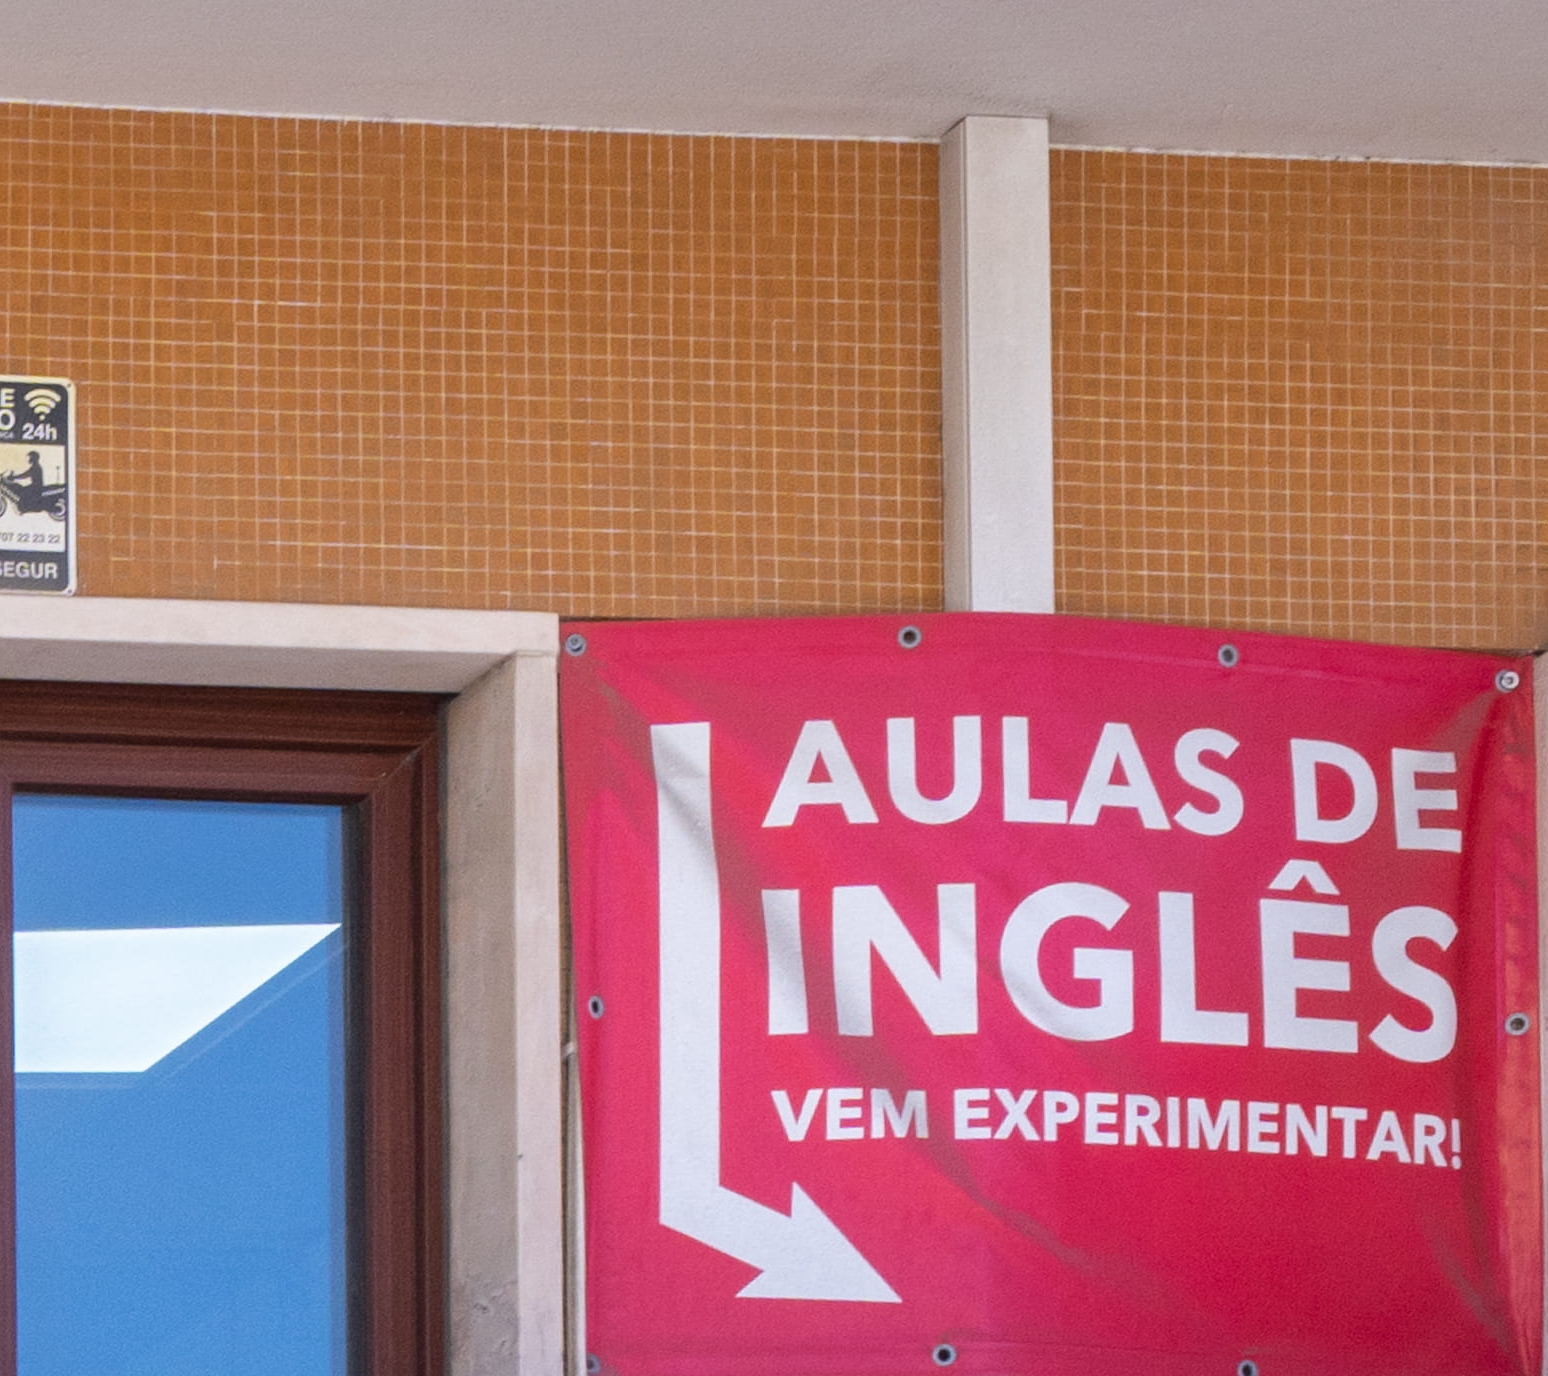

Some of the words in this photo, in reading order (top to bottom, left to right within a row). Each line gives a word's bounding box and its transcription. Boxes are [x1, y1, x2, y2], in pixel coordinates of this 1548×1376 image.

[21, 422, 58, 441] 24h
[17, 531, 31, 545] 22
[47, 532, 62, 545] 22
[761, 715, 1246, 837] AULAS
[1289, 737, 1463, 853] DE
[760, 858, 1460, 1063] INGLÊS
[769, 1087, 930, 1143] VEM
[955, 1087, 1463, 1170] EXPERIMENTAR!
